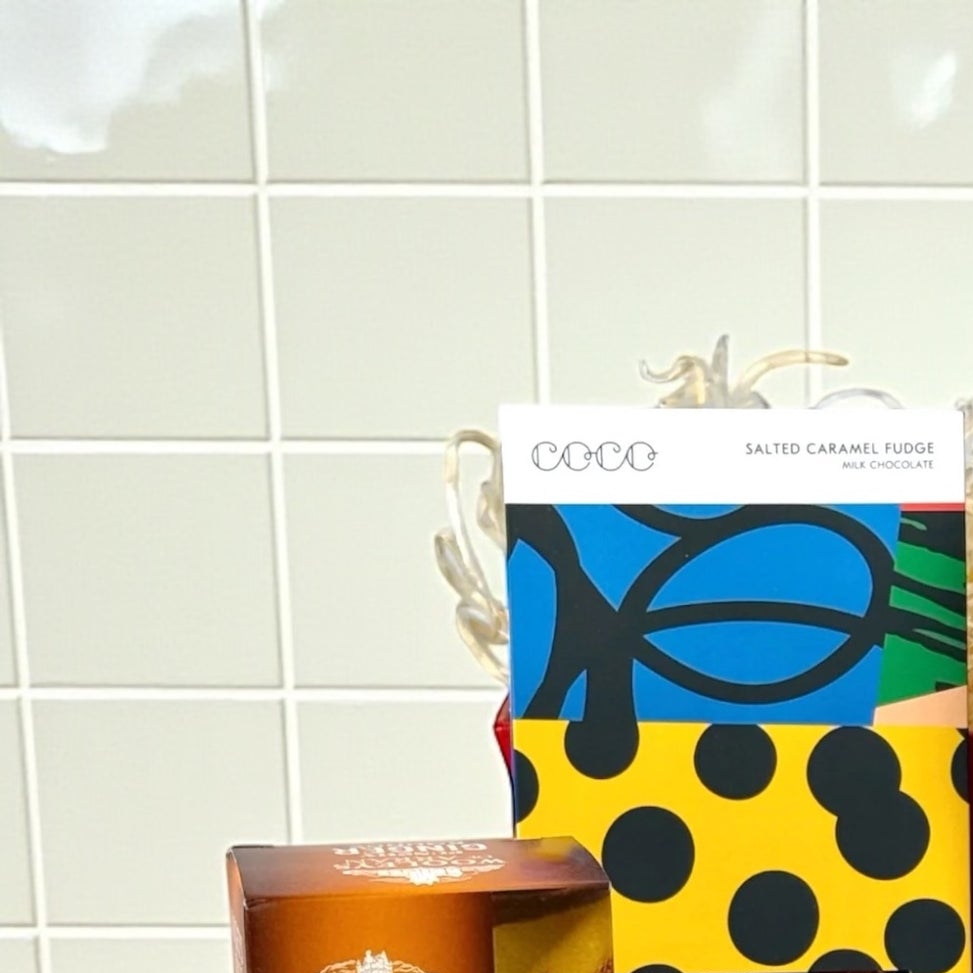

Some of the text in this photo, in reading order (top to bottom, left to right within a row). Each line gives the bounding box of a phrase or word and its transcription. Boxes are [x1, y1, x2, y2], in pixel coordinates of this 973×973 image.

[746, 442, 935, 455] SALTED CARAMEL FUDGE
[842, 460, 935, 470] MILK CHOCOLATE
